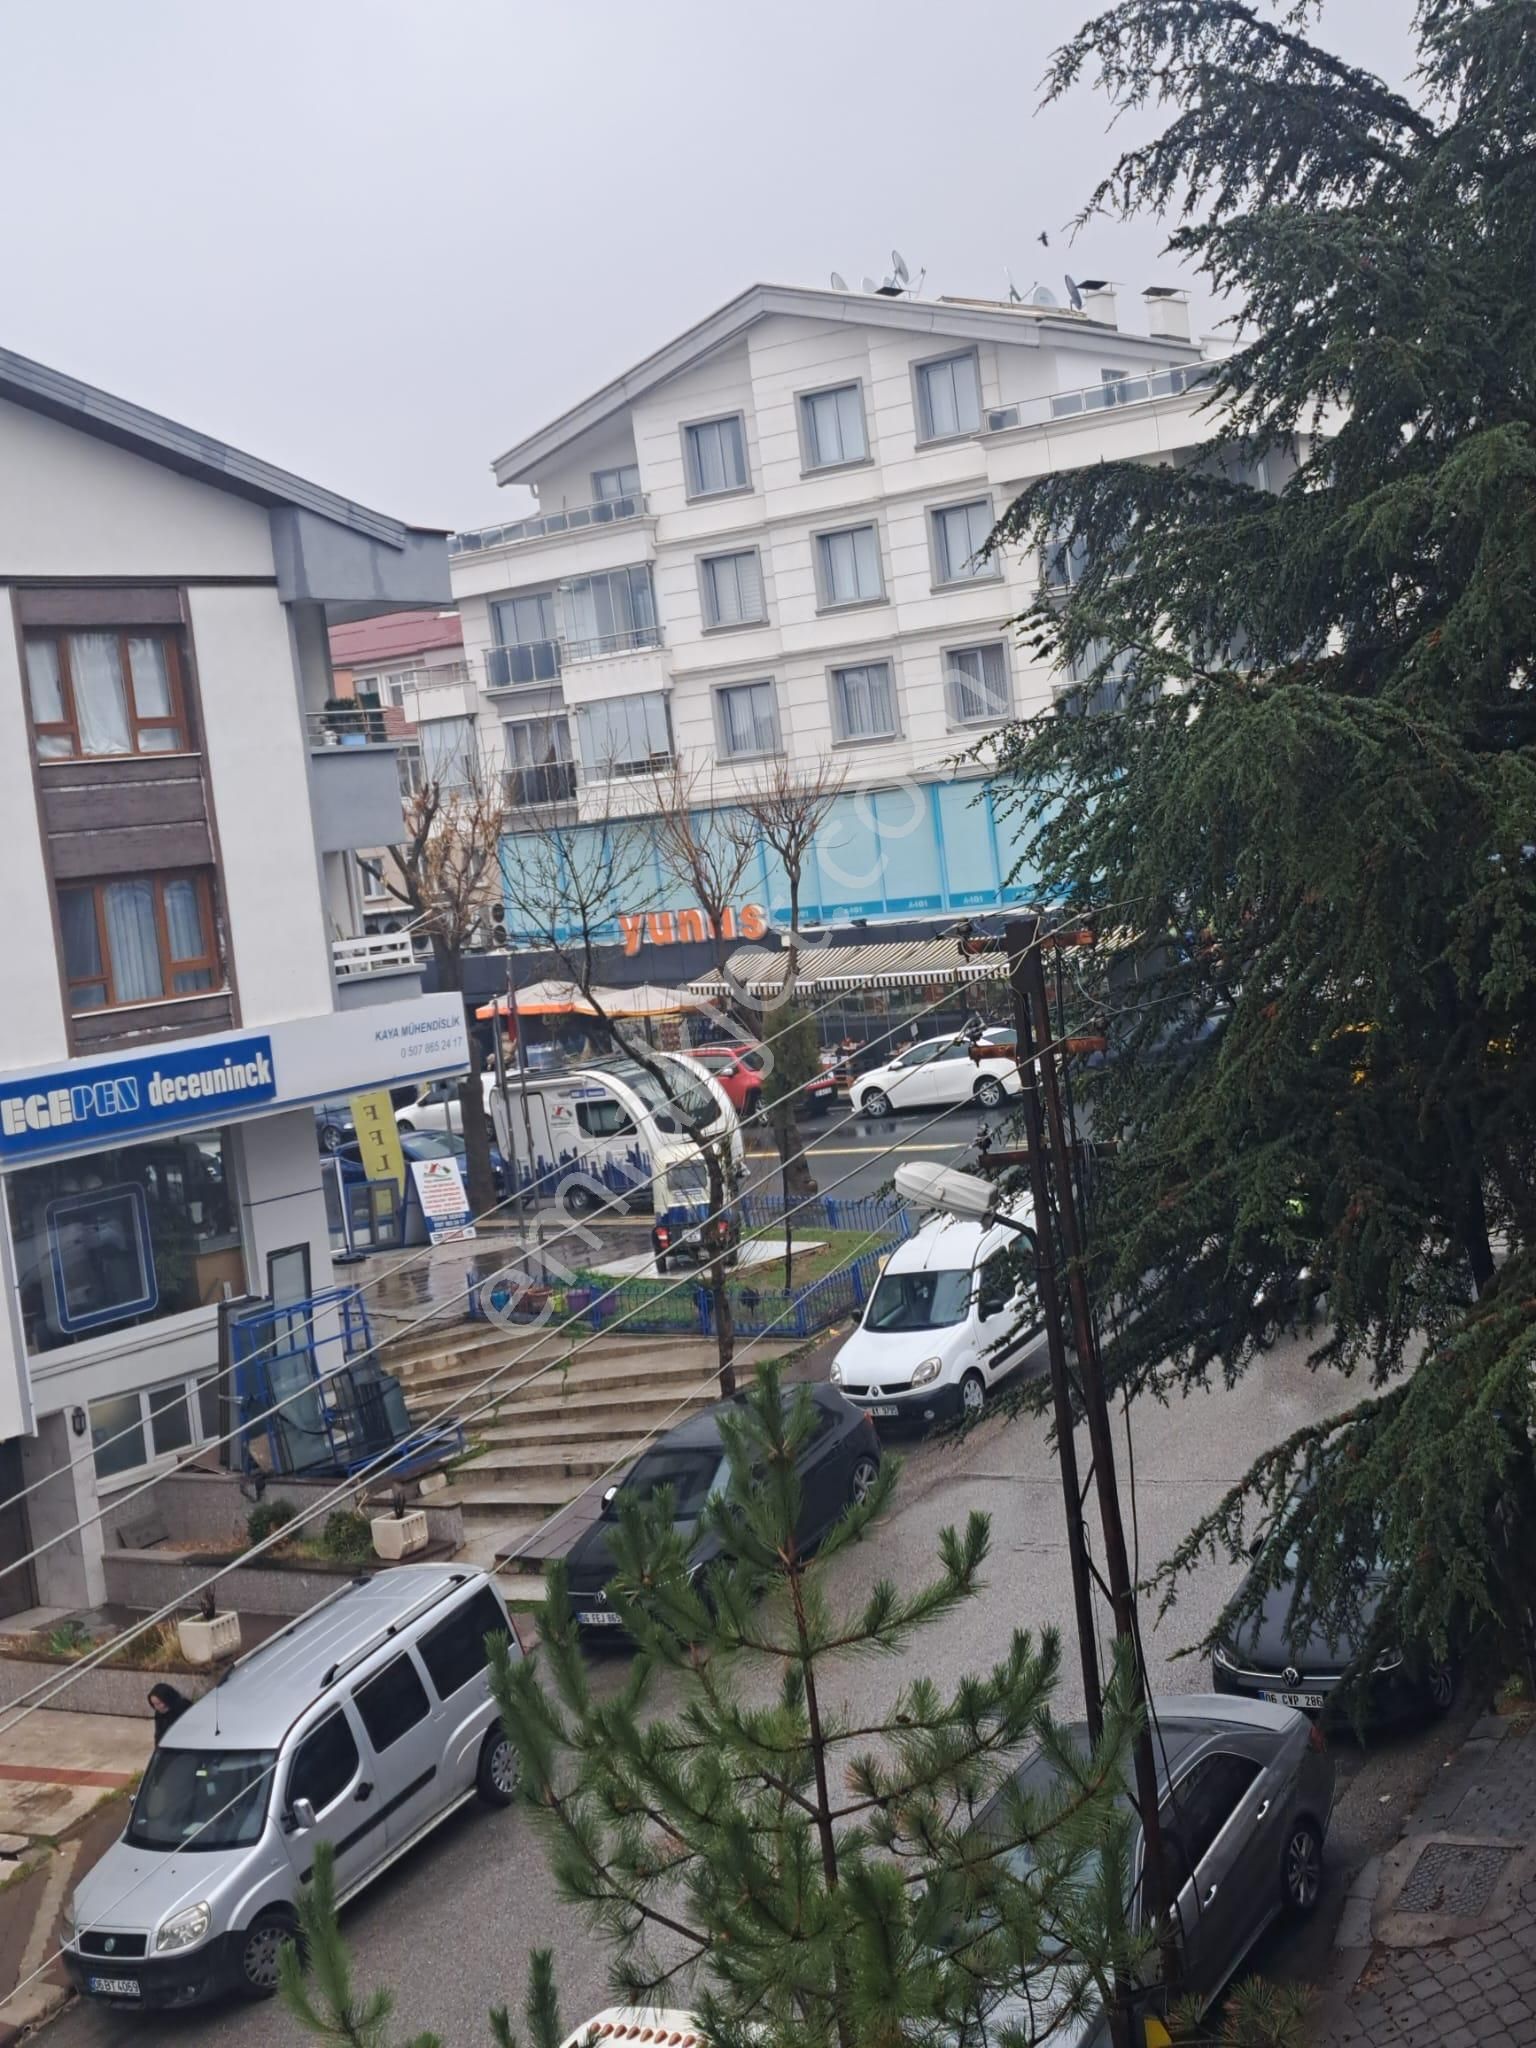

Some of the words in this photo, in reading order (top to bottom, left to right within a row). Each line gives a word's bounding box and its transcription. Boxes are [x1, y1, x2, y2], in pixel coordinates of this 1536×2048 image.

[618, 903, 769, 957] yunus
[375, 1028, 399, 1041] KAYA
[401, 1016, 461, 1037] MÜHENDİSLİK
[408, 1044, 423, 1056] 507
[441, 1039, 451, 1050] 24
[0, 1077, 140, 1136] EGEPEN
[149, 1052, 273, 1107] deceuninck
